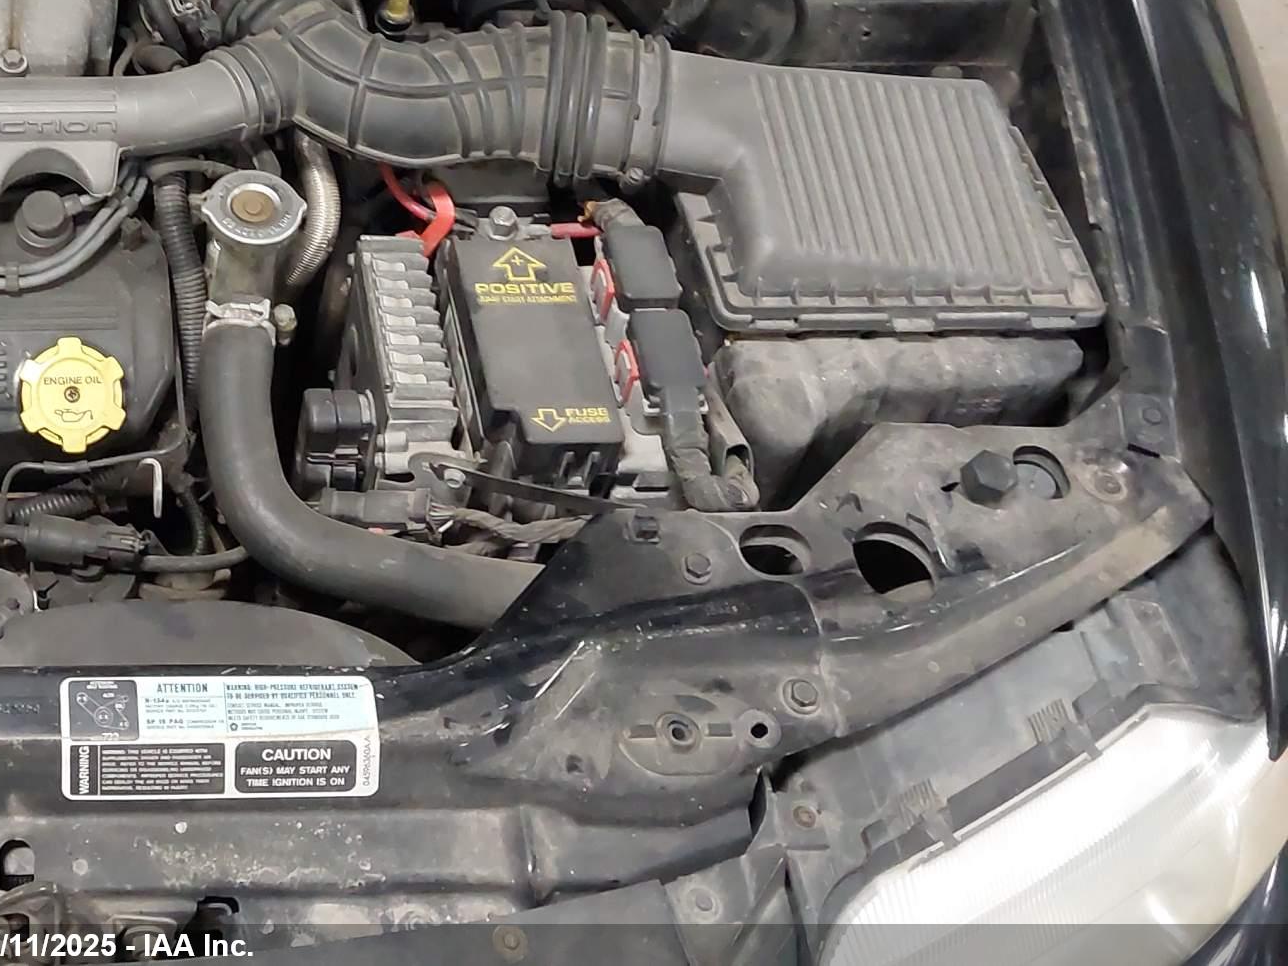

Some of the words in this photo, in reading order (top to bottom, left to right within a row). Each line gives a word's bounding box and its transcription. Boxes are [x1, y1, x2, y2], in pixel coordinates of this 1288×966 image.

[475, 282, 576, 294] POSITIVE
[43, 376, 83, 385] ENGINE
[85, 376, 102, 384] OIL
[565, 407, 609, 417] FUSE
[157, 683, 208, 693] ATTENTION
[262, 748, 332, 761] CAUTION
[79, 746, 90, 794] WARNING
[240, 766, 273, 775] FAN(S)
[276, 766, 295, 774] MAY
[299, 766, 328, 774] START
[331, 766, 350, 774] ANY
[247, 778, 269, 786] TIME
[272, 778, 314, 786] IGNITION
[316, 778, 327, 786] IS
[330, 777, 345, 785] ON
